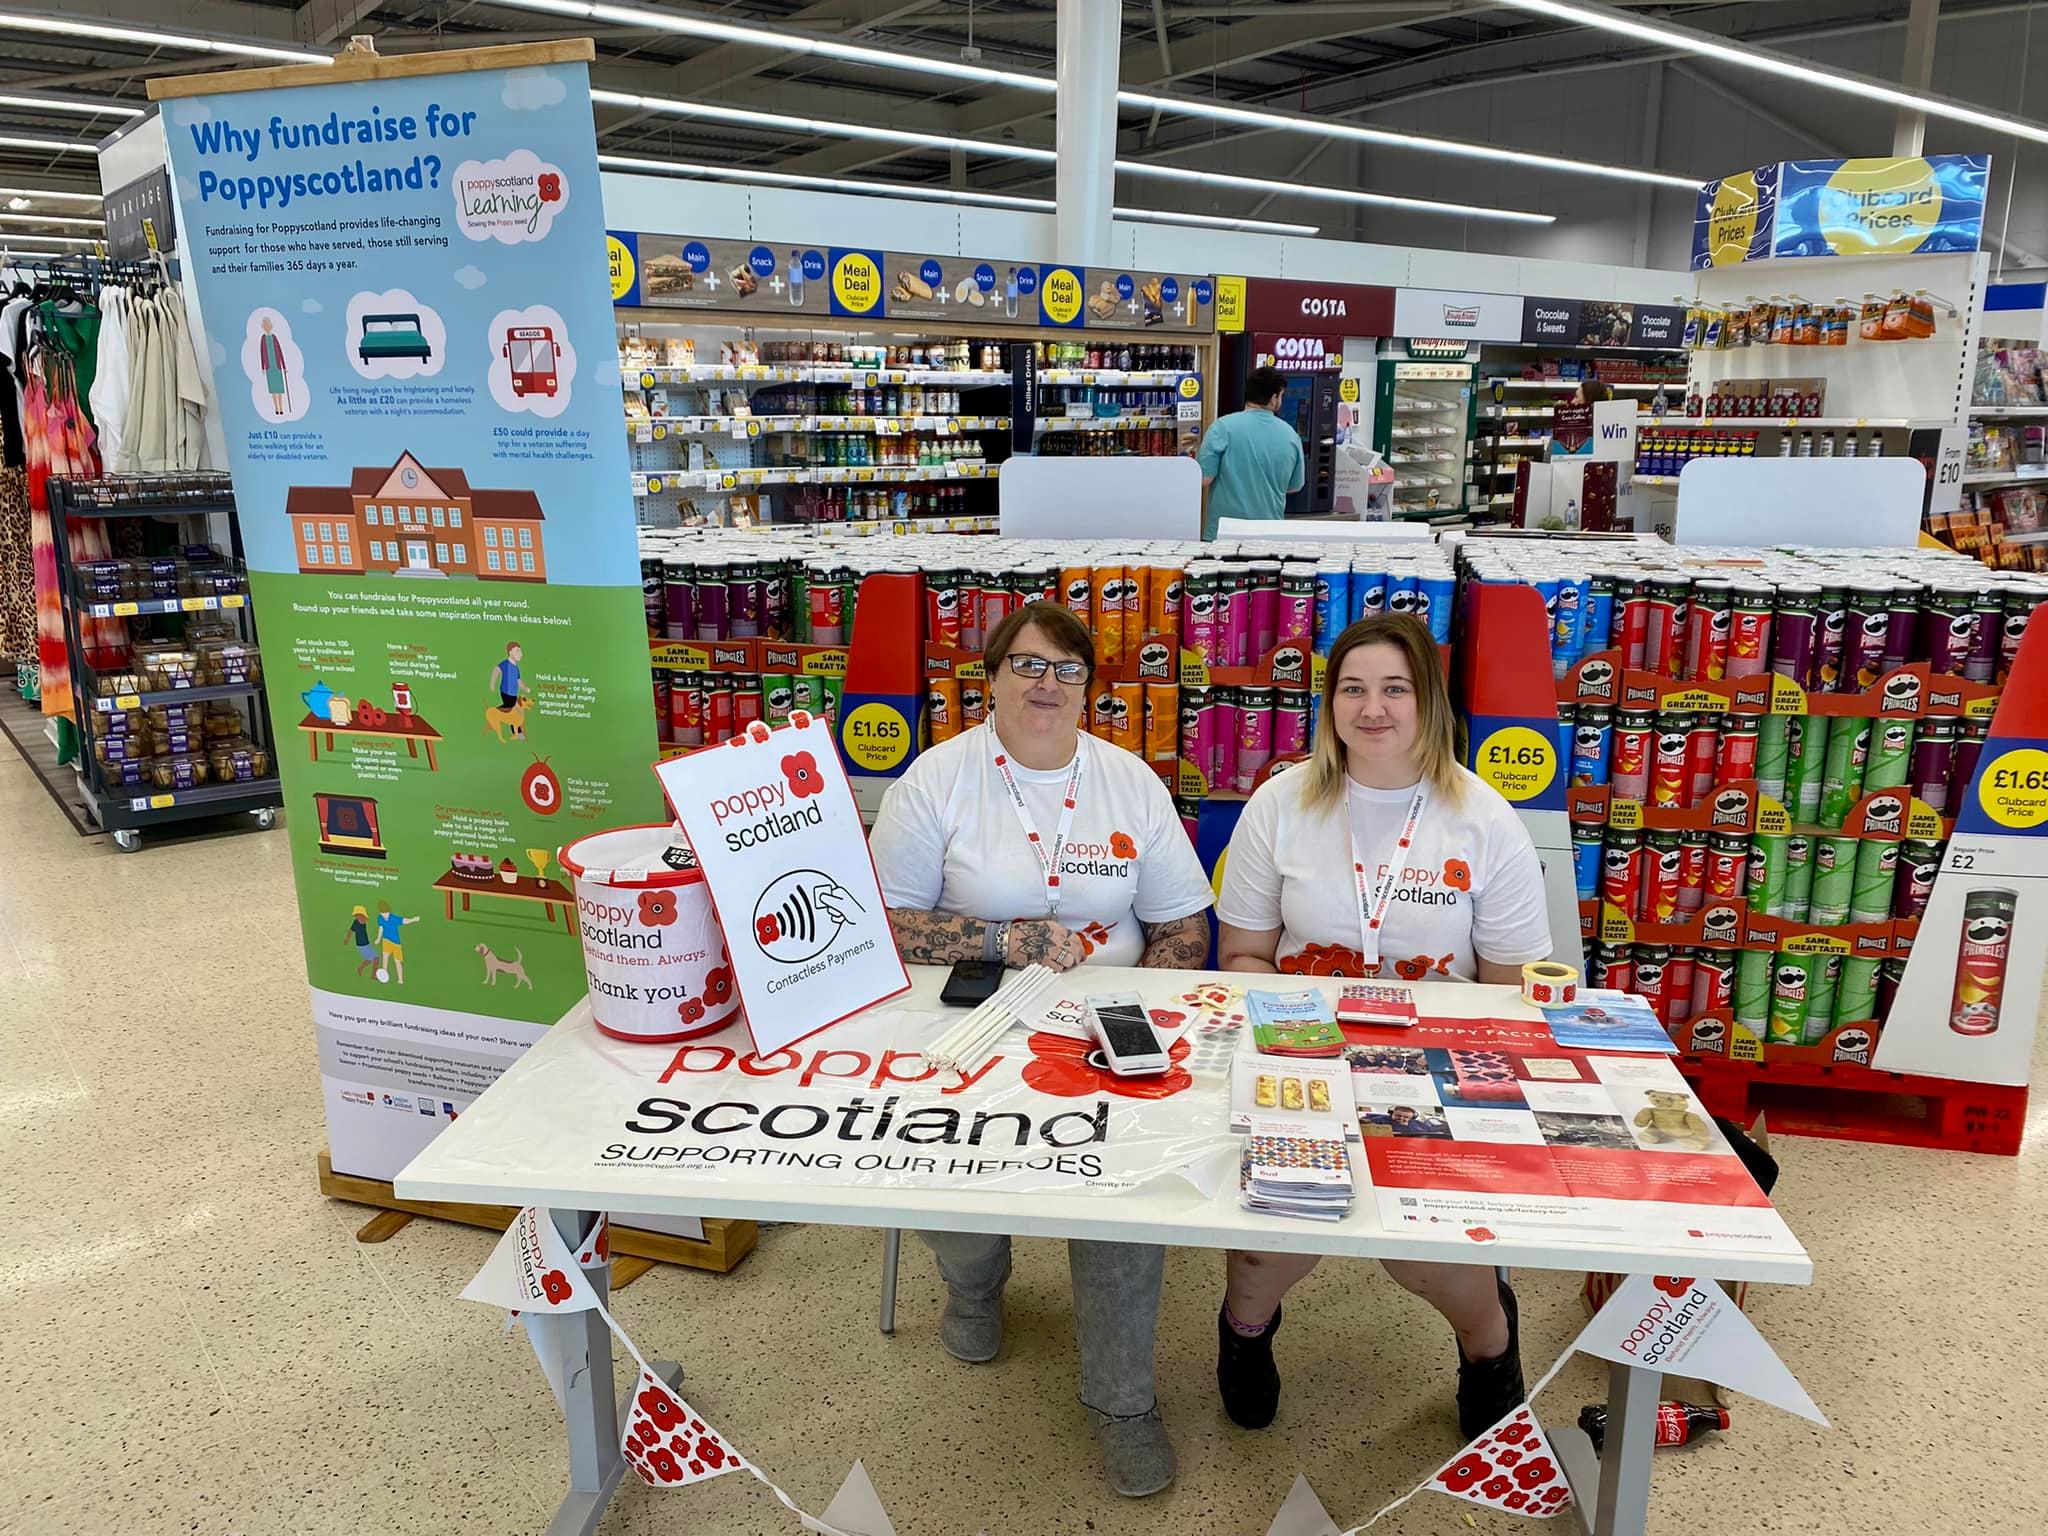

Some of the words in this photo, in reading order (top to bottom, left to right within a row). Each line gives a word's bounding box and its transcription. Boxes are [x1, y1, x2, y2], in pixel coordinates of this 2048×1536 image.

[191, 120, 261, 162] Why
[269, 105, 417, 150] fundraise
[426, 103, 477, 138] for
[198, 154, 442, 210] Poppyscotland?
[467, 173, 534, 192] poppyscotland
[1836, 186, 1933, 207] lubcard
[460, 179, 545, 234] Learning
[205, 224, 254, 237] Fundraising
[256, 222, 270, 234] for
[271, 219, 337, 236] Poppyscotland
[339, 217, 379, 232] provides
[380, 214, 441, 229] life-changing
[1847, 210, 1914, 229] Prices
[1717, 225, 1746, 244] Prices
[208, 244, 240, 257] support
[244, 242, 258, 254] for
[260, 242, 286, 253] those
[287, 240, 307, 252] who
[308, 238, 330, 251] have
[332, 237, 366, 250] served,
[367, 236, 393, 248] those
[395, 235, 412, 247] still
[413, 234, 449, 248] serving
[687, 252, 706, 263] Main
[751, 256, 773, 267] Snack
[211, 264, 226, 274] and
[228, 262, 248, 273] their
[249, 261, 285, 273] families
[286, 260, 304, 271] 365
[306, 259, 327, 273] days
[335, 260, 358, 272] year.
[803, 260, 823, 271] Drink
[843, 263, 871, 278] Meal
[923, 270, 939, 279] Main
[976, 272, 994, 283] Snack
[1019, 276, 1035, 286] Drink
[844, 277, 871, 292] Deal
[1050, 278, 1074, 291] Meal
[1162, 286, 1177, 294] Snack
[1051, 291, 1074, 304] Deal
[1218, 294, 1237, 305] Meal
[1218, 304, 1236, 316] Deal
[1301, 297, 1347, 318] COSTA
[1535, 307, 1570, 321] Chocolate
[1542, 321, 1567, 334] Sweets
[1641, 314, 1672, 326] Chocolate
[1647, 327, 1668, 339] Sweets
[1274, 336, 1325, 360] COSTA
[1024, 348, 1033, 378] Drinks
[1282, 359, 1325, 371] EXPRESS
[336, 395, 348, 405] As
[348, 395, 367, 405] little
[369, 397, 378, 405] as
[379, 395, 395, 405] £20
[1024, 379, 1033, 413] Chilled
[248, 431, 263, 440] Just
[264, 430, 278, 440] £10
[493, 427, 509, 437] £50
[510, 427, 533, 437] could
[535, 427, 568, 442] provide
[576, 429, 590, 439] day
[1601, 423, 1627, 440] Win
[1945, 447, 1961, 459] From
[1939, 462, 1960, 484] £10
[402, 523, 427, 533] SCHOOL
[327, 590, 342, 600] You
[344, 592, 358, 601] can
[360, 591, 396, 602] fundraise
[397, 592, 410, 602] for
[411, 593, 470, 607] Poppyscotland
[471, 596, 482, 606] all
[483, 598, 501, 609] year
[503, 599, 530, 609] round.
[293, 602, 318, 612] Round
[319, 604, 330, 615] up
[331, 605, 350, 615] your
[351, 604, 379, 616] friends
[380, 606, 395, 616] and
[396, 606, 415, 617] take
[415, 609, 437, 618] some
[438, 609, 481, 621] inspiration
[482, 611, 503, 622] from
[504, 612, 518, 622] the
[519, 613, 541, 624] ideas
[543, 615, 572, 626] below!
[665, 647, 689, 656] SAME
[715, 649, 745, 664] PRINGLES
[767, 650, 797, 666] PRINGLES
[652, 655, 679, 664] GREAT
[679, 656, 705, 665] TASTE
[1139, 663, 1169, 678] PRINGLES
[1272, 667, 1302, 682] PRINGLES
[1578, 683, 1612, 698] PRINGLES
[1683, 693, 1709, 701] SAME
[1666, 701, 1696, 709] GREAT
[1697, 701, 1725, 710] TASTE
[1882, 696, 1919, 711] PRINGLES
[852, 720, 900, 738] £1.65
[857, 743, 896, 753] Clubcard
[865, 752, 888, 762] Price
[1488, 746, 1545, 766] £1.65
[1492, 771, 1538, 783] Clubcard
[1993, 769, 2048, 790] £1.65
[1002, 765, 1025, 808] poppyscotland
[1501, 781, 1528, 791] Price
[709, 777, 786, 826] poppy
[1996, 796, 2047, 808] Clubcard
[1404, 795, 1424, 838] poppyscotland
[1912, 814, 1936, 822] SAME
[2006, 806, 2035, 818] Price
[725, 799, 823, 852] scotland
[1863, 818, 1900, 834] PRINGLES
[1909, 821, 1937, 829] GREAT
[670, 849, 694, 857] SECU
[1065, 842, 1109, 860] oppy
[668, 855, 697, 867] SEA
[1951, 854, 1975, 870] £2
[1377, 863, 1440, 887] pppy
[1375, 875, 1395, 919] poppyscotland
[579, 896, 634, 928] poppy
[581, 921, 662, 949] scotland
[1703, 927, 1736, 943] PRINGLES
[616, 952, 654, 967] them.
[657, 949, 709, 967] Always.
[766, 957, 827, 995] Contactless
[827, 936, 876, 967] Payments
[588, 970, 639, 1001] Thank
[644, 984, 687, 1004] you
[1418, 1026, 1479, 1036] POPPY
[1834, 1049, 1868, 1064] PRINGLES
[657, 1045, 1005, 1093] poppy
[624, 1095, 1110, 1148] scotland
[600, 1143, 842, 1170] SUPPORTING
[854, 1153, 937, 1175] OUR
[527, 1206, 547, 1270] poppy
[519, 1213, 544, 1299] scotland
[1620, 1296, 1673, 1356] poppy
[1643, 1288, 1709, 1365] scotland
